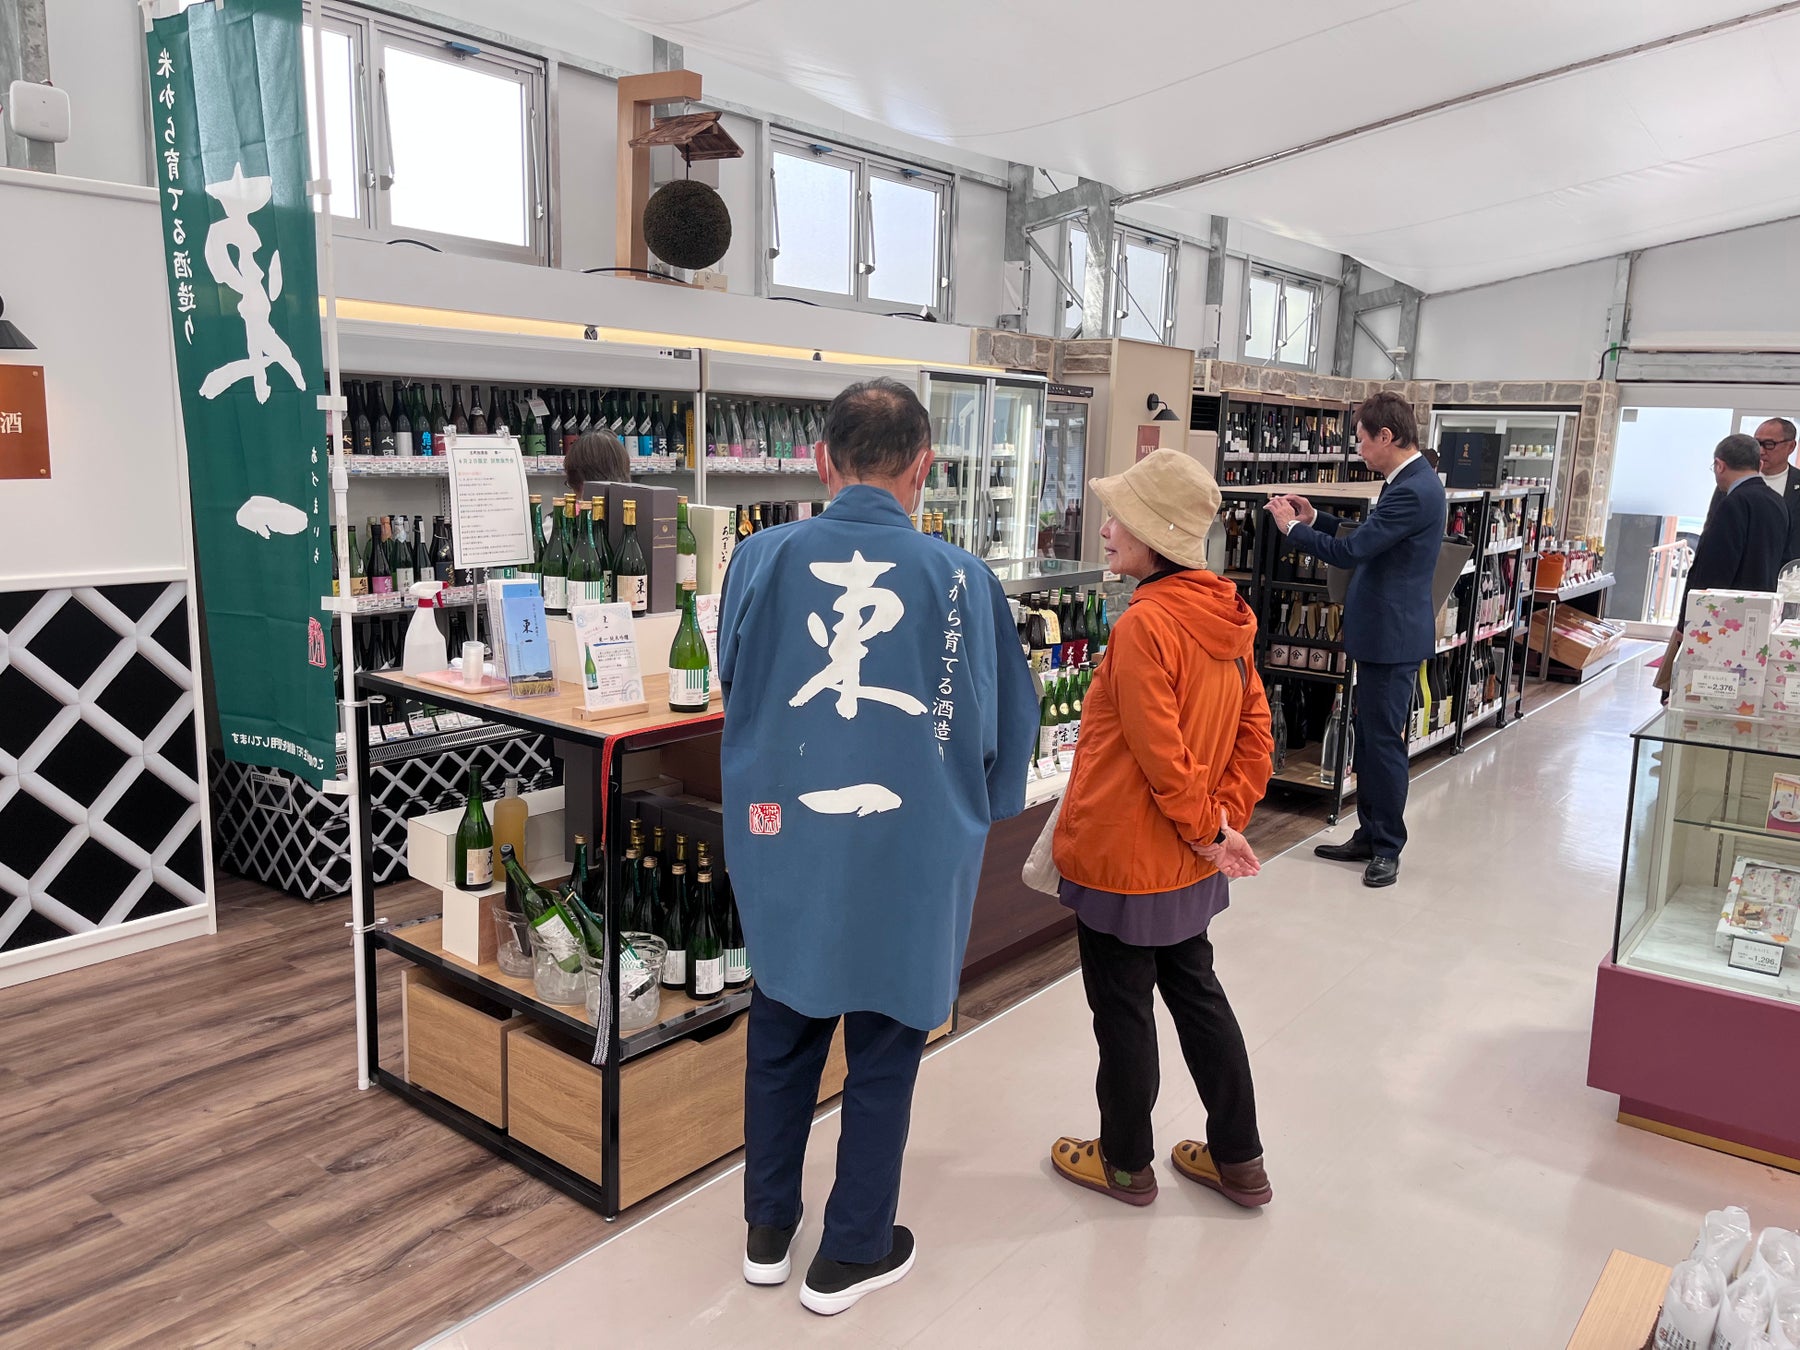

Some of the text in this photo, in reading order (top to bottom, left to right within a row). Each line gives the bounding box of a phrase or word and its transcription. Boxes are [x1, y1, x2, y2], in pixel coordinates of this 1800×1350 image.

[0, 411, 23, 434] 酒
[721, 526, 730, 562] あづまいち
[522, 618, 533, 643] 東一
[931, 566, 968, 762] 米から育てる酒造り
[788, 549, 929, 819] 東一
